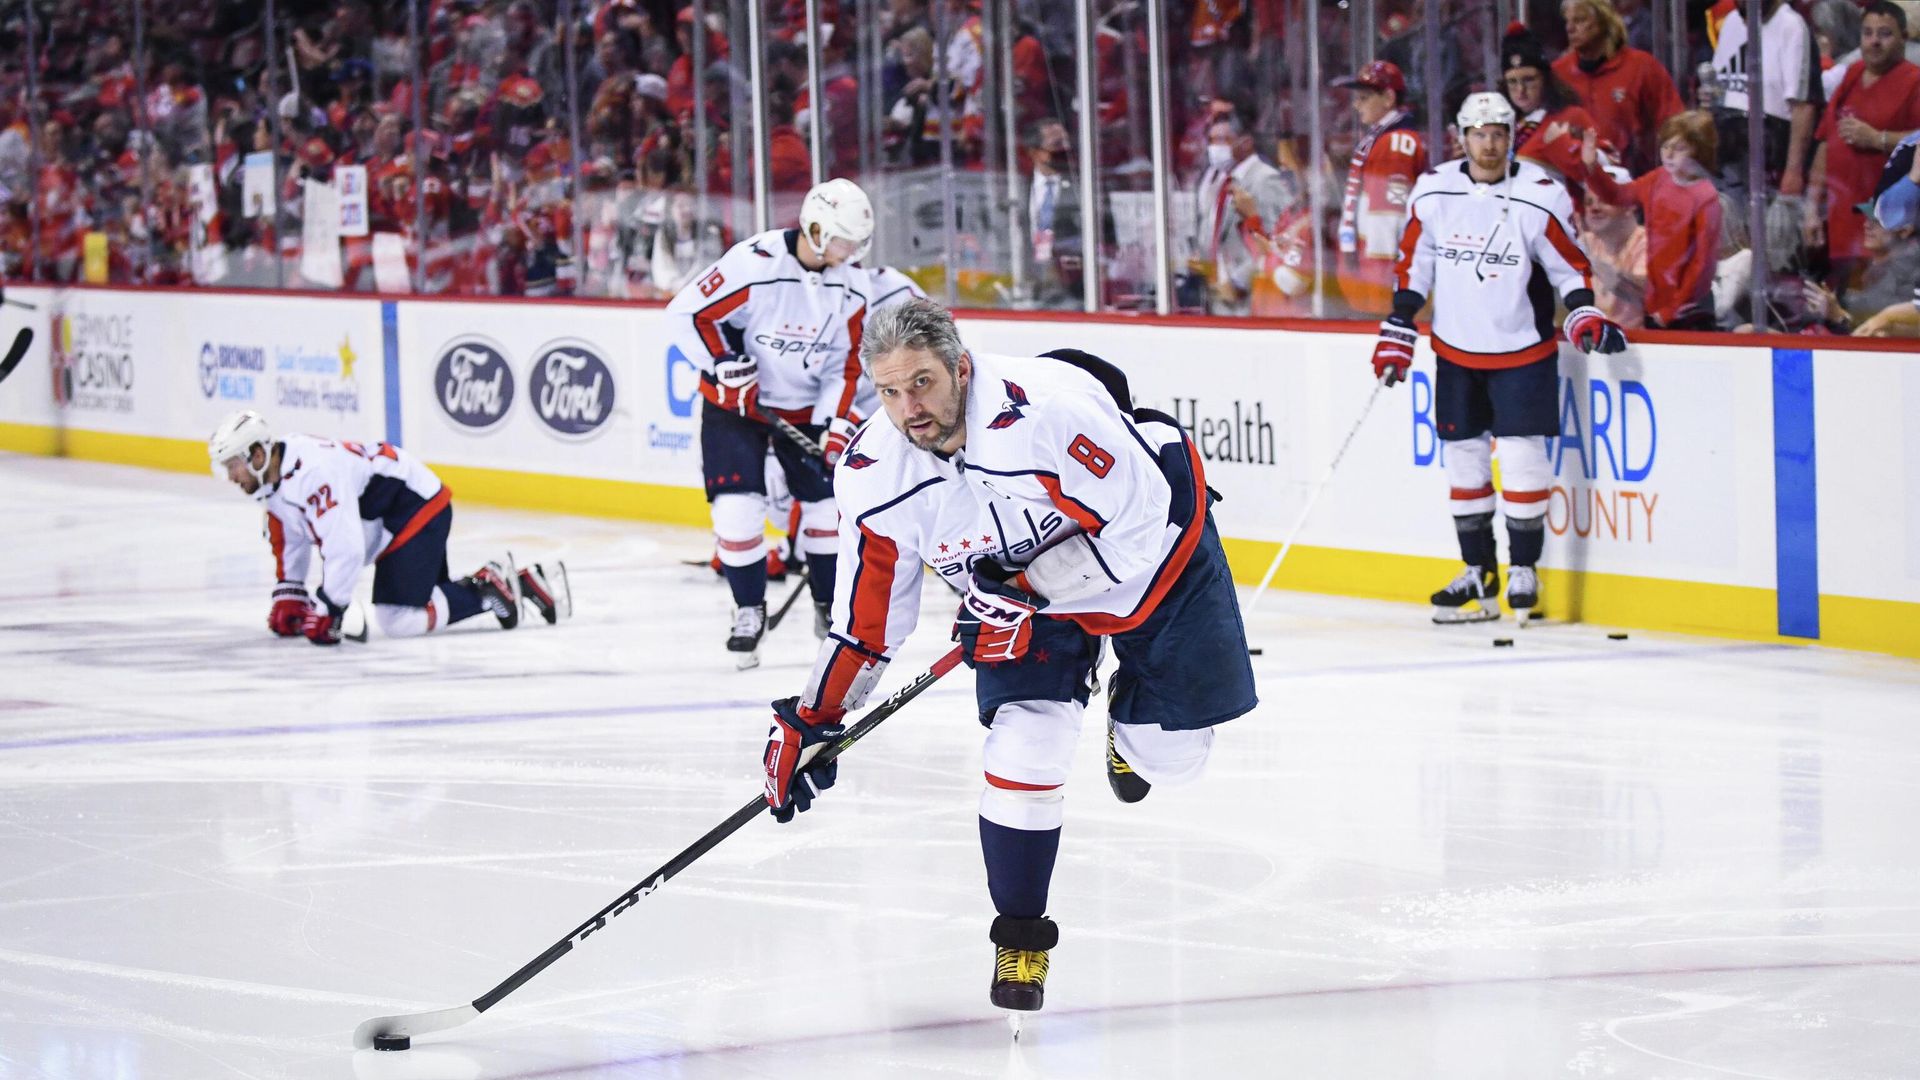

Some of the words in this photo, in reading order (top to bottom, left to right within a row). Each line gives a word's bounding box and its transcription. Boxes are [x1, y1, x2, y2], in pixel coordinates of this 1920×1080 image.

[1390, 132, 1417, 156] 10
[697, 266, 725, 298] 19
[77, 351, 134, 390] CASINO
[446, 347, 503, 415] Ford
[541, 351, 603, 421] Ford
[1173, 398, 1276, 465] Health
[1412, 371, 1657, 481] BARD
[1067, 433, 1115, 479] 8
[306, 483, 338, 518] 22
[1544, 485, 1658, 544] OUNTY
[965, 589, 1024, 623] CM
[568, 873, 665, 951] CCM
